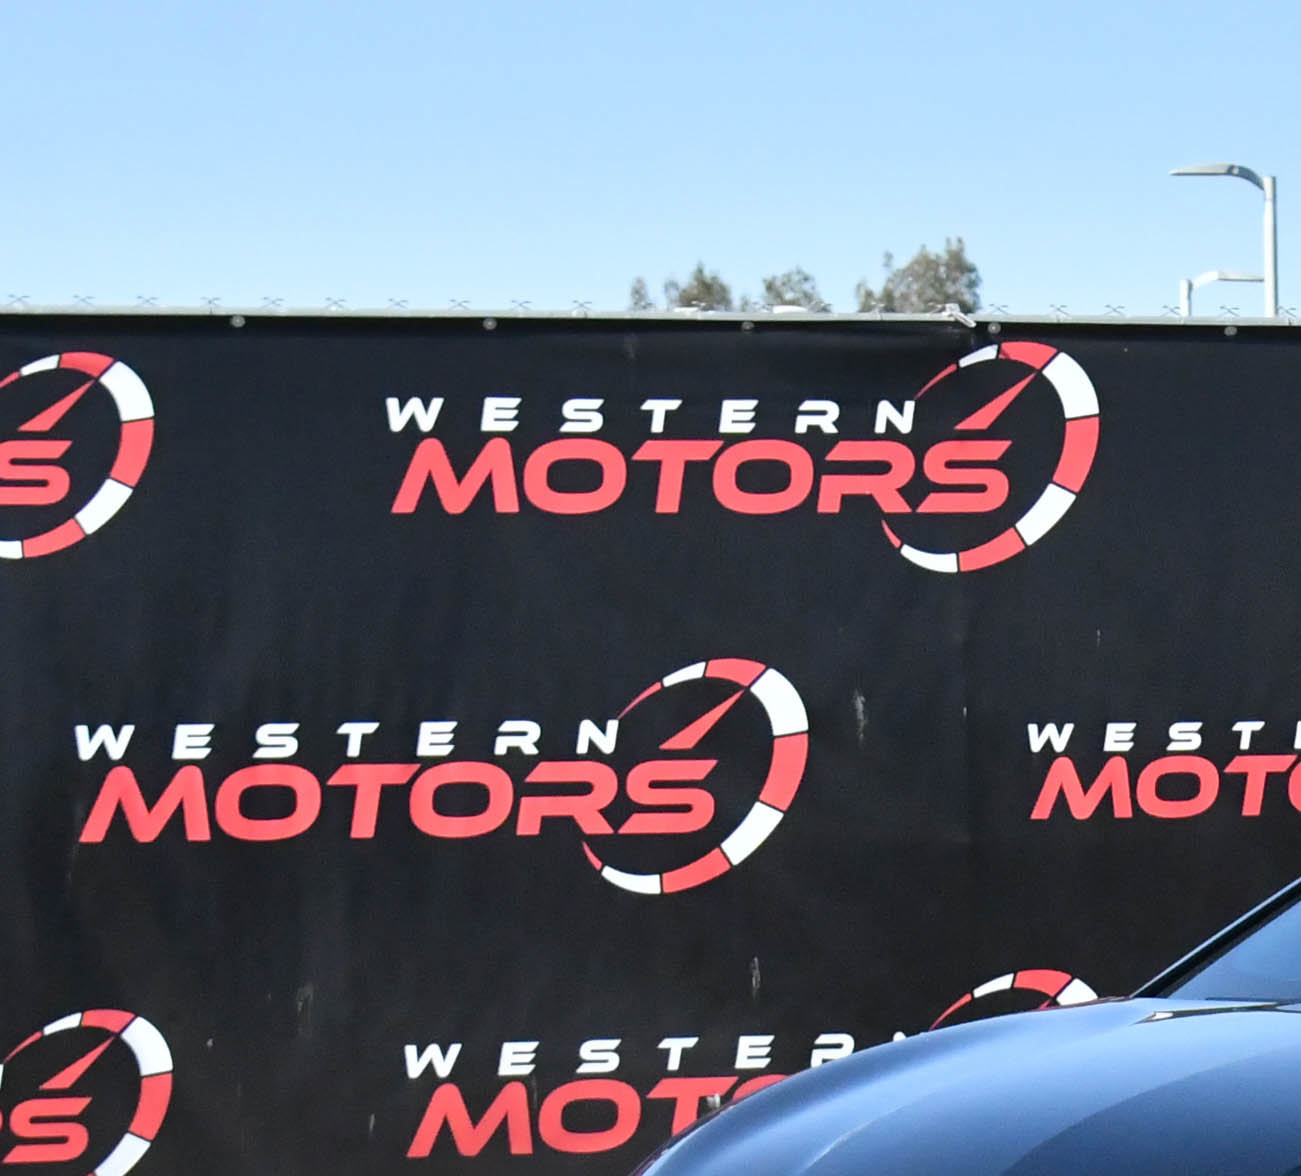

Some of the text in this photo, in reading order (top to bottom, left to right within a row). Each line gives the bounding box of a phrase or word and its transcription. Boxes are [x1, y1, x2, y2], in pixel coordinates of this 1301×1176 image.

[385, 396, 916, 435] WESTERN
[391, 436, 1012, 515] MOTORS
[74, 719, 621, 762] WESTERN
[78, 758, 719, 844] MOTORS
[404, 1031, 907, 1080] WESTER
[406, 1073, 789, 1159] MOT
